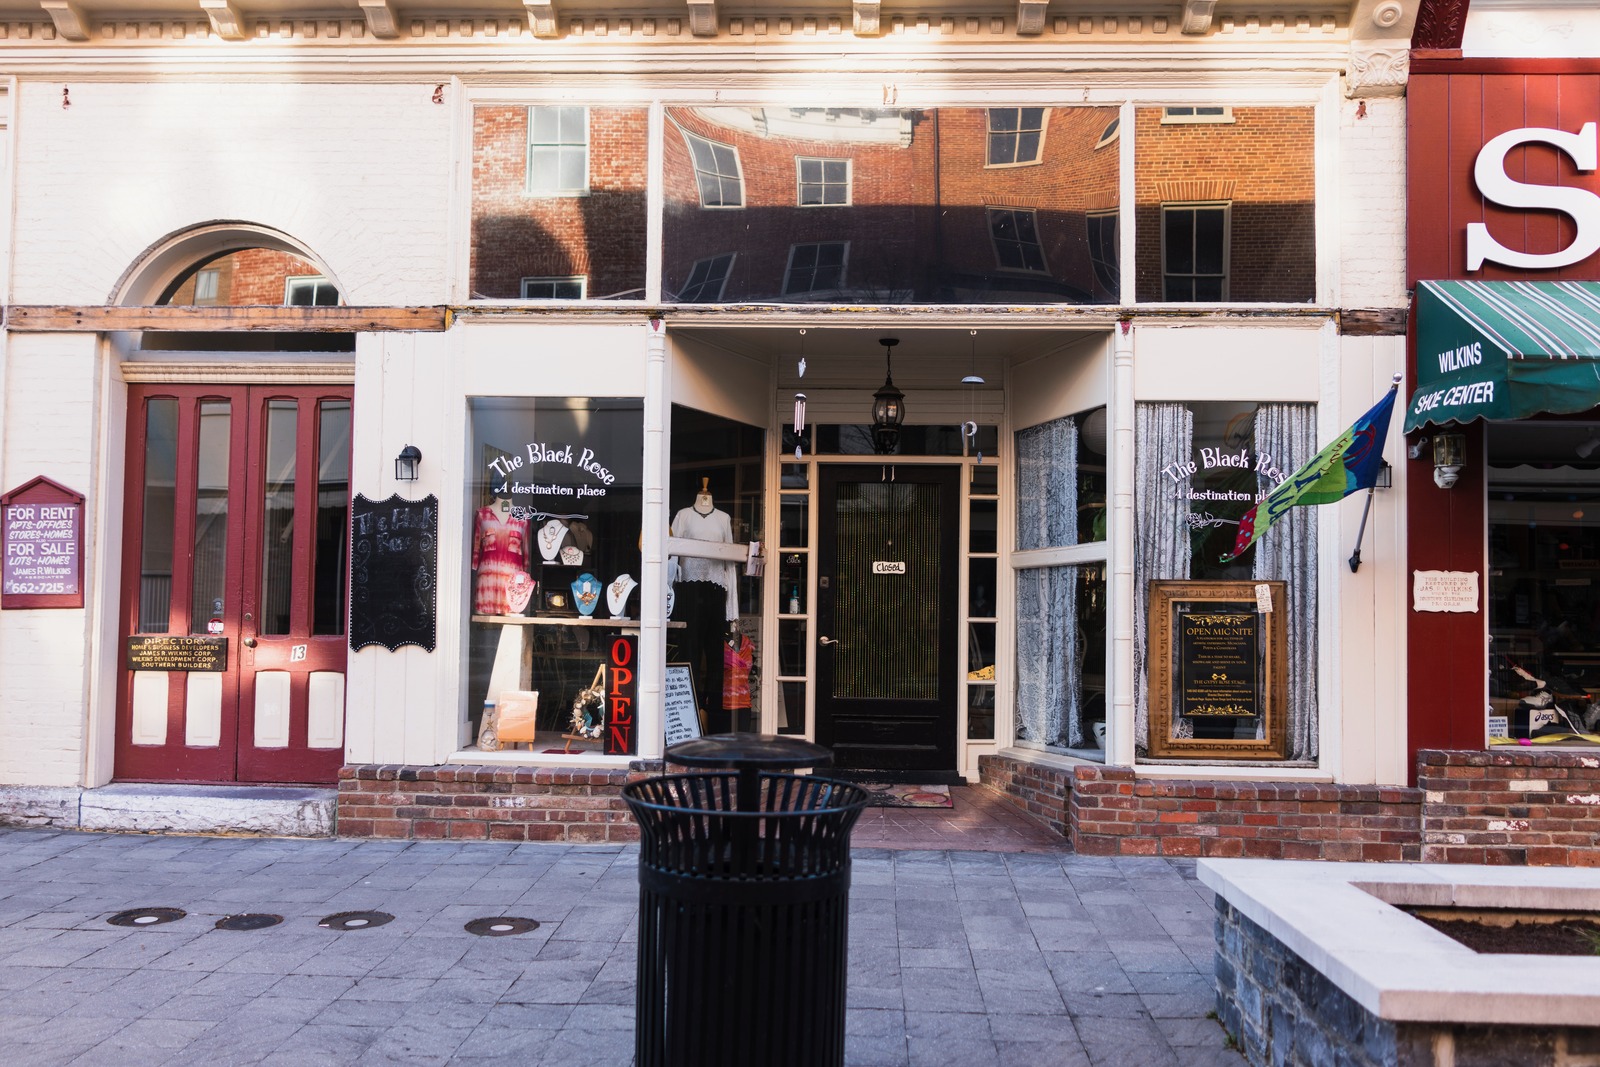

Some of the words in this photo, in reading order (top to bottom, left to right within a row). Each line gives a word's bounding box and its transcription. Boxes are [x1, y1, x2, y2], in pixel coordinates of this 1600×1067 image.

[1467, 122, 1600, 271] S
[1438, 342, 1482, 374] WILKINS
[1414, 389, 1444, 414] SHOE
[1443, 380, 1494, 406] CENTER
[488, 454, 524, 478] The
[526, 442, 574, 464] Black
[577, 448, 616, 486] Rose
[1161, 460, 1198, 484] The
[1200, 447, 1250, 470] Black
[1254, 452, 1288, 484] Ros
[494, 480, 508, 494] A
[512, 482, 574, 496] destination
[577, 484, 606, 499] place
[1172, 488, 1182, 500] A
[1186, 489, 1250, 500] destination
[8, 508, 34, 520] FOR
[40, 507, 76, 519] RENT
[9, 520, 73, 530] APTS-OFFICES
[8, 530, 73, 540] STORES-HOMES
[8, 544, 34, 556] FOR
[40, 542, 75, 555] SALE
[8, 556, 70, 566] LOTS-HOMES
[876, 562, 904, 572] Closed
[292, 646, 306, 660] 13
[608, 638, 632, 754] OPEN
